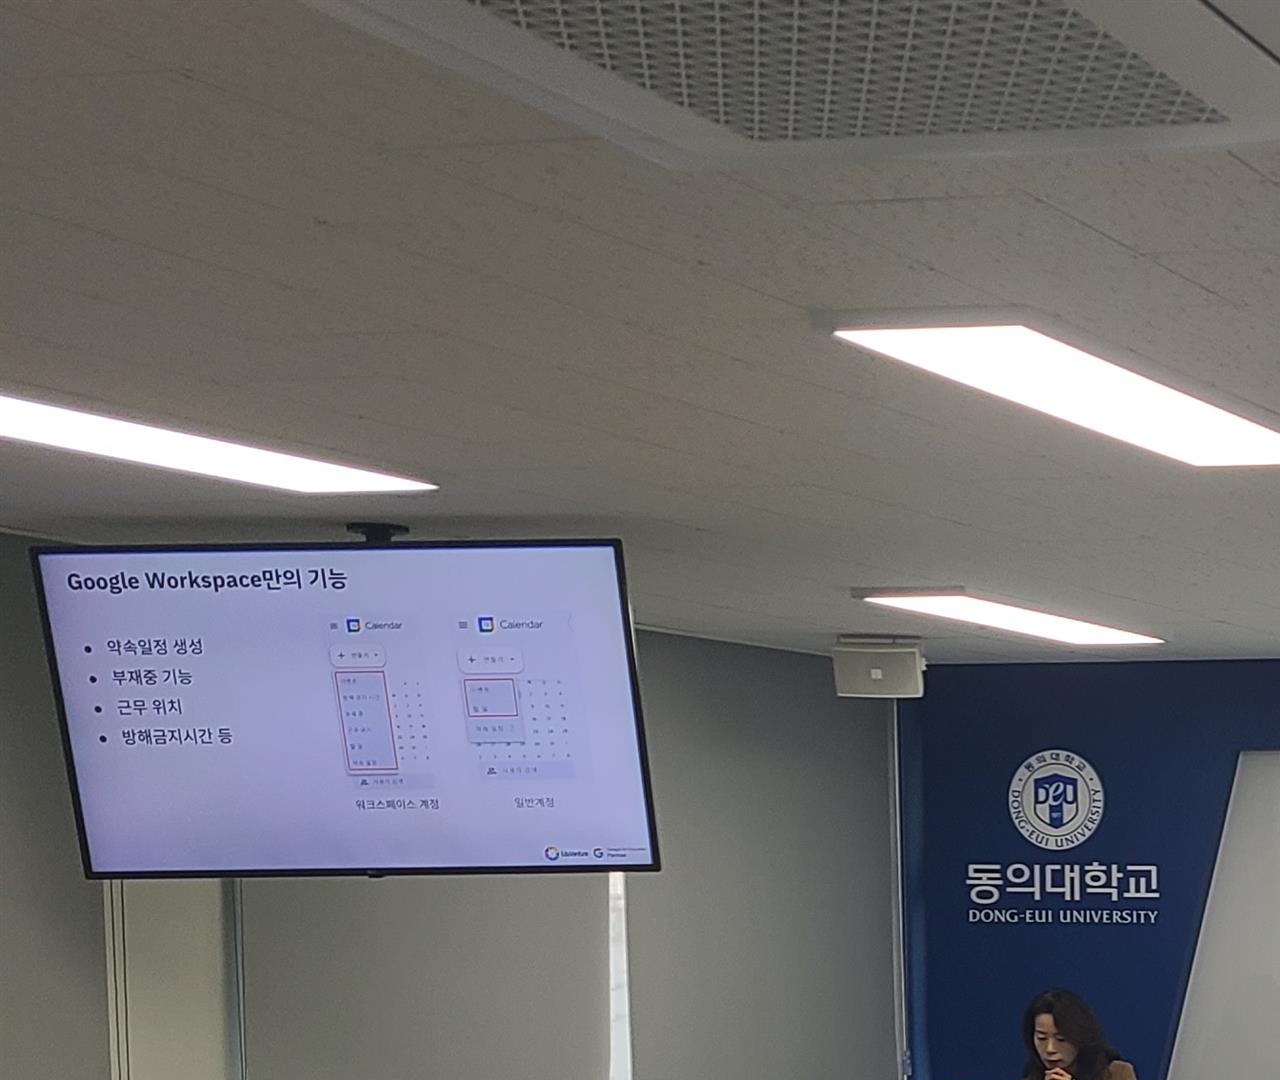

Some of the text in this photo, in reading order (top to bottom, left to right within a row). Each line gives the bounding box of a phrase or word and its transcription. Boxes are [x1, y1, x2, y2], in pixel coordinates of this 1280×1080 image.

[67, 569, 347, 594] Google Workspace만의 기능
[107, 639, 203, 655] 약속일정 생성
[112, 669, 192, 686] 부재중 기능
[117, 699, 183, 716] 근무 위치
[122, 728, 232, 745] 방해금지시간 등
[965, 861, 1160, 904] 동의대학교
[968, 910, 1159, 924] DONG-EUI UNIVERSITY
